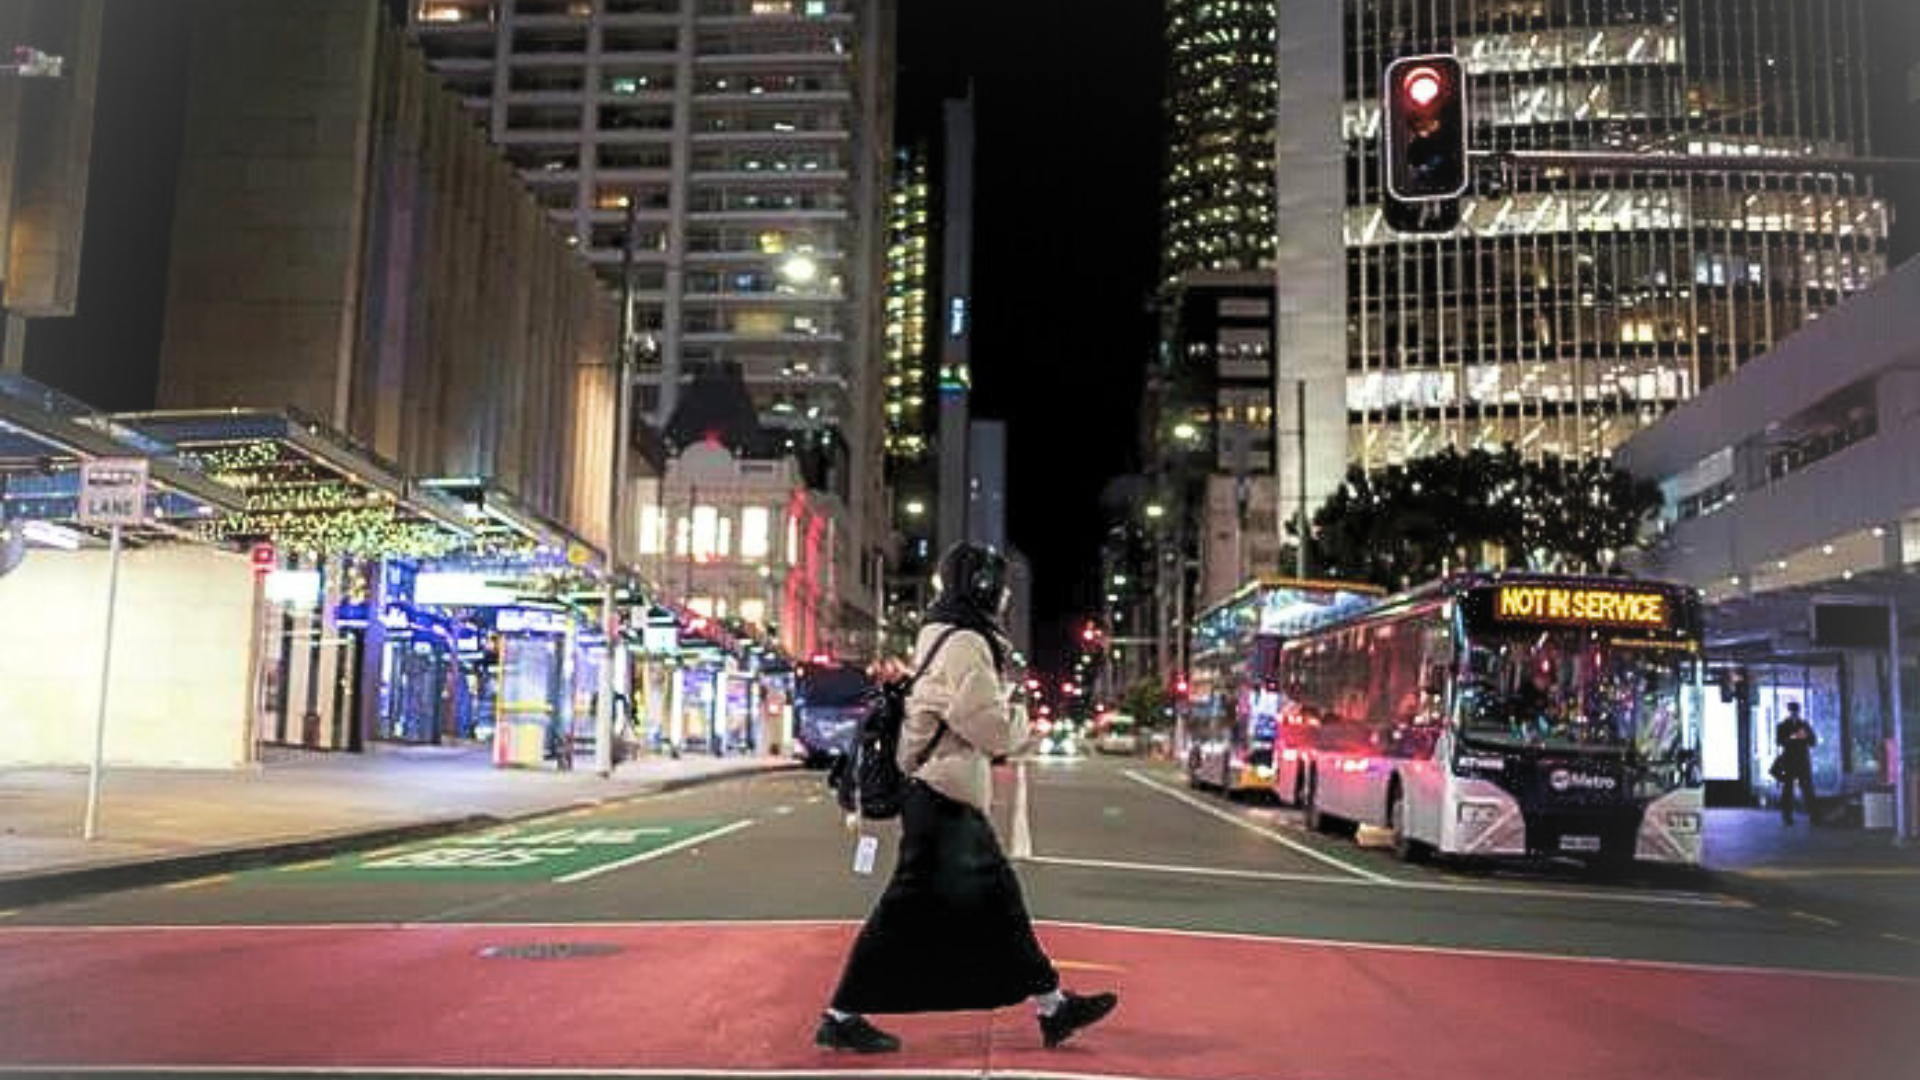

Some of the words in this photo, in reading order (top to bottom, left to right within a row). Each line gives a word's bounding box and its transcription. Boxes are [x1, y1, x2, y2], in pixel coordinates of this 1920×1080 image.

[88, 499, 133, 516] LANE
[1501, 586, 1546, 616] NOT
[1549, 588, 1570, 617] IN
[1572, 589, 1664, 621] SERVICE
[1571, 771, 1616, 789] Metro
